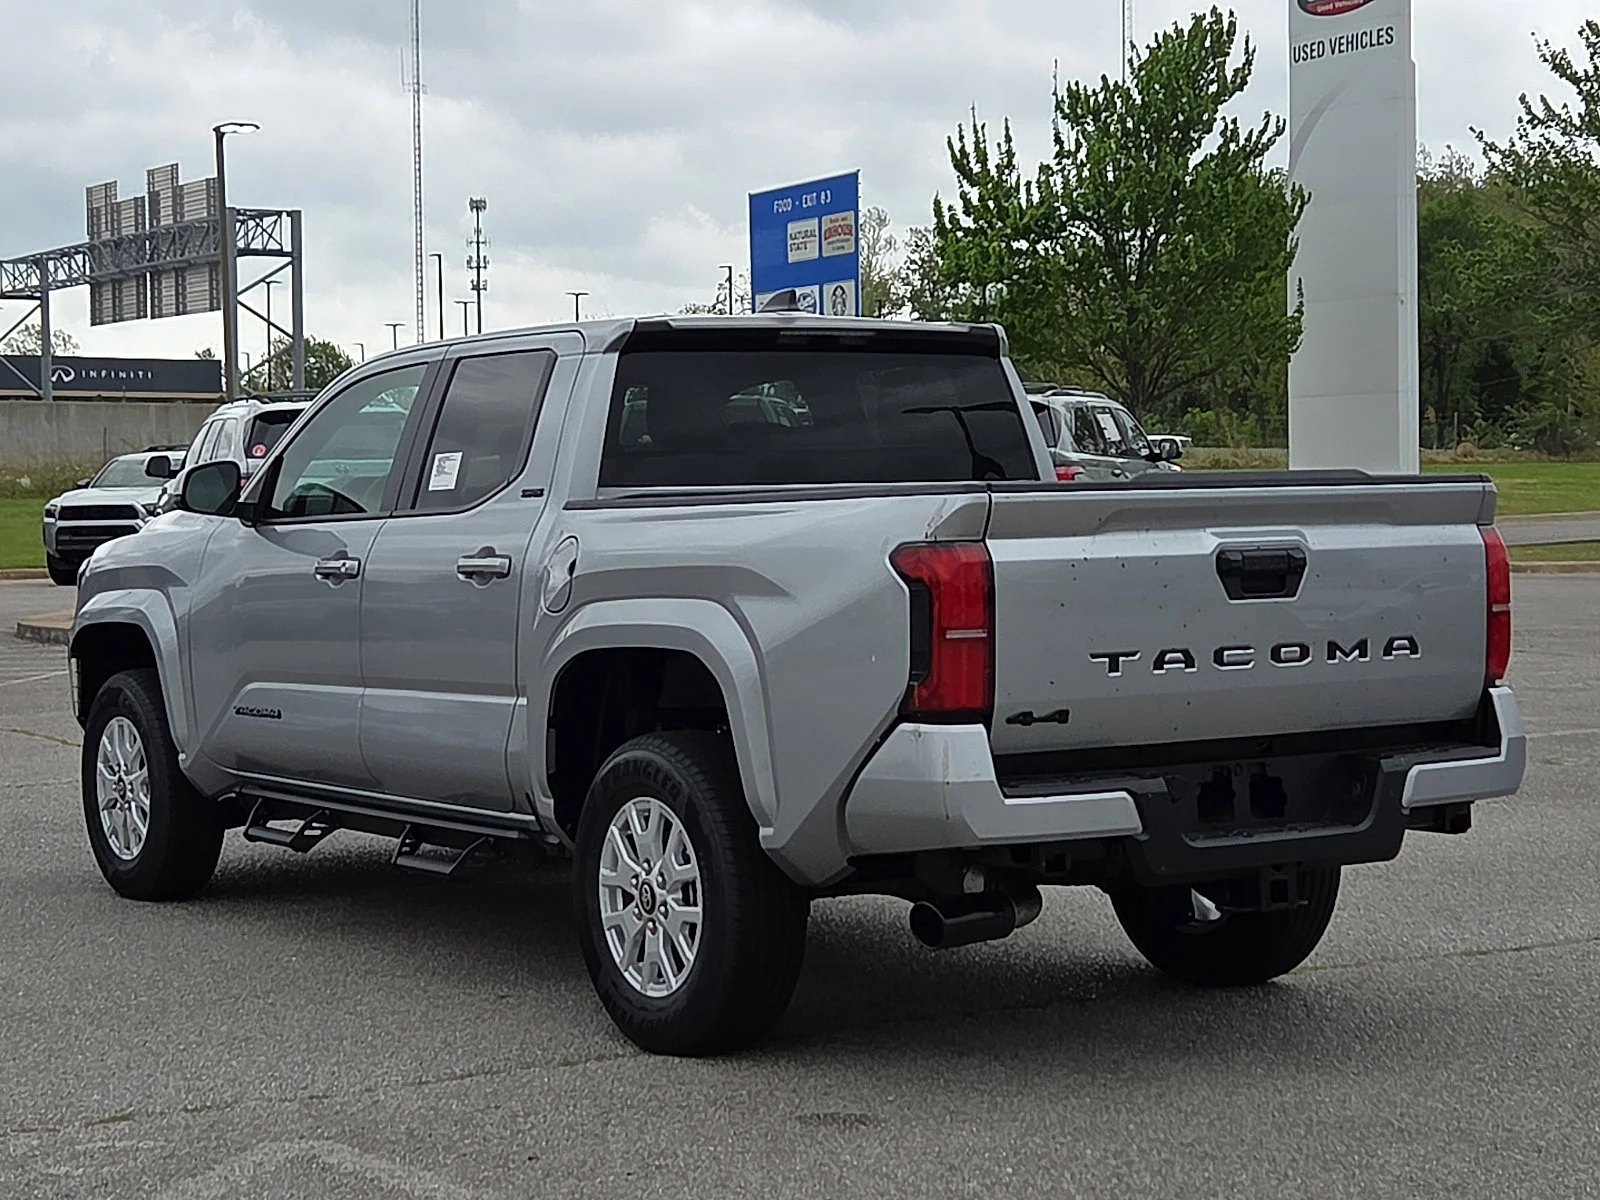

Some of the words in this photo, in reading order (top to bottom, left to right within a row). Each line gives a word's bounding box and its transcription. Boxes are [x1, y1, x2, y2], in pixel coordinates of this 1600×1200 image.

[1293, 40, 1325, 63] USED
[1329, 26, 1394, 56] VEHICLES
[774, 198, 792, 214] FOOD
[802, 192, 817, 208] EXIT
[789, 229, 817, 241] NATURAL
[789, 241, 808, 253] STATE
[81, 369, 151, 379] INFINITI
[1088, 635, 1421, 677] TACOMA
